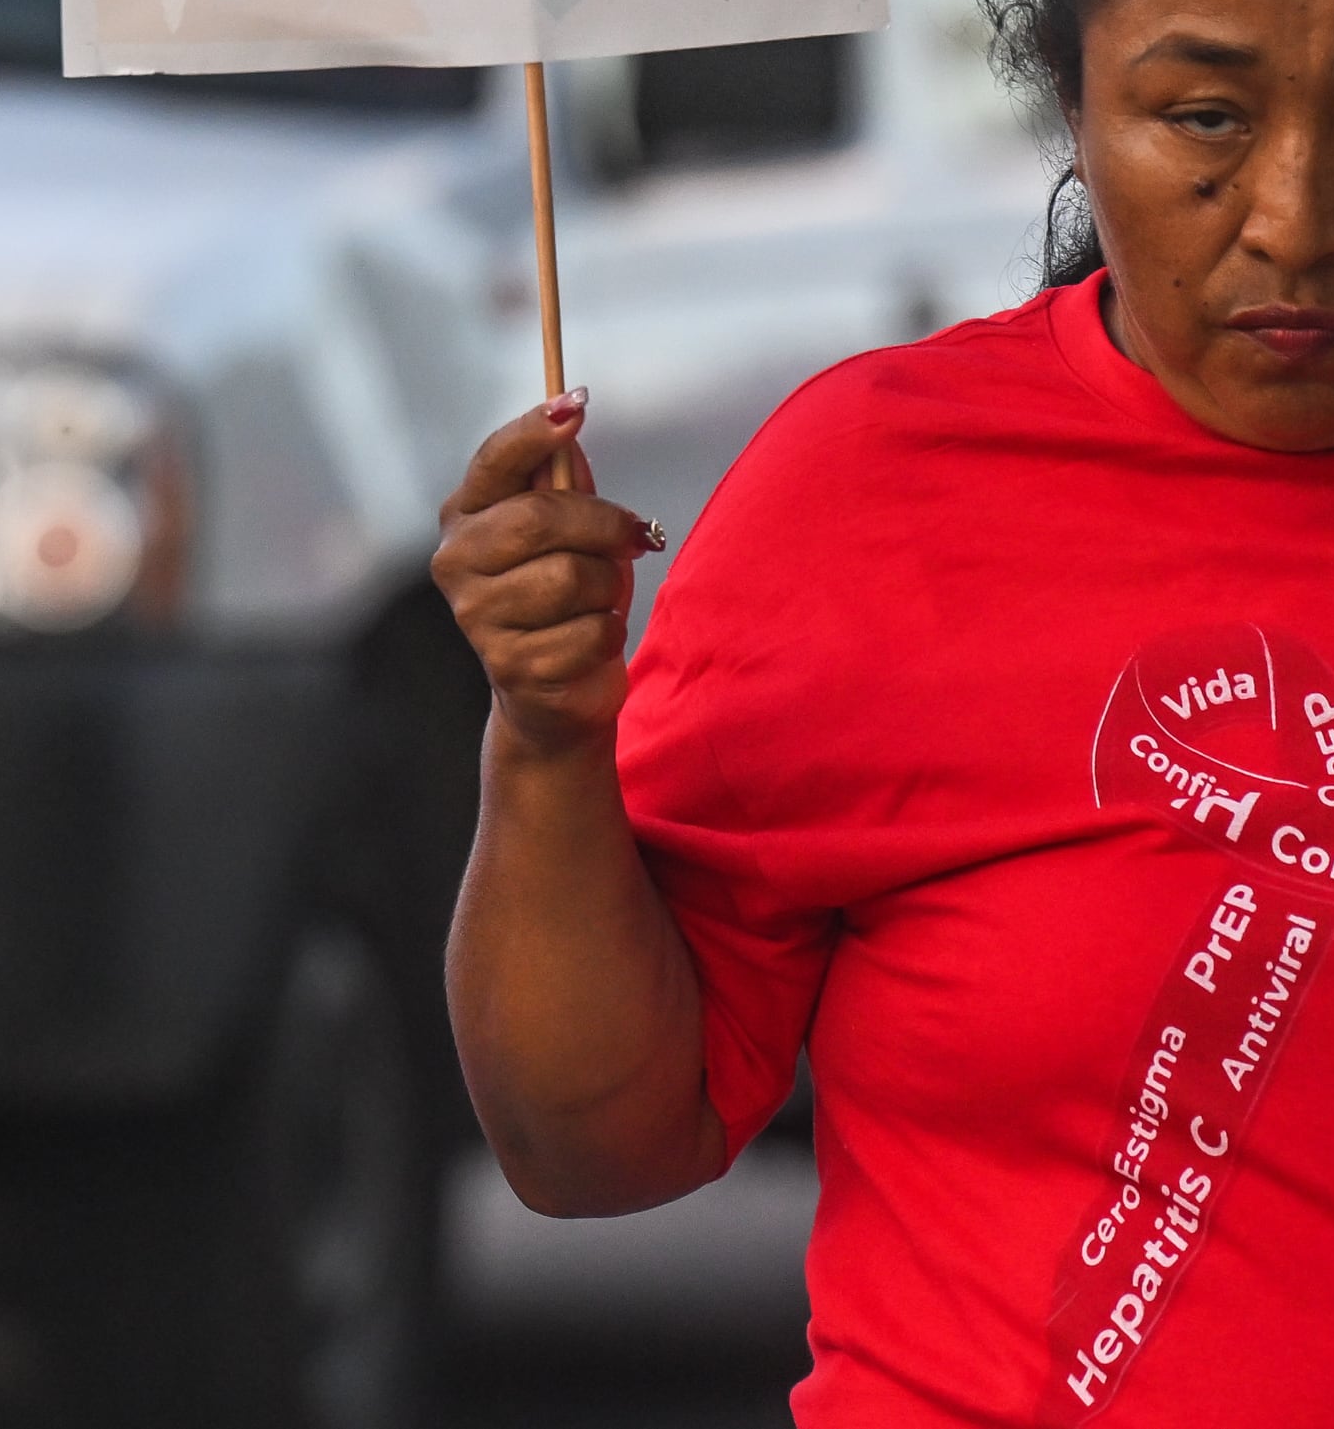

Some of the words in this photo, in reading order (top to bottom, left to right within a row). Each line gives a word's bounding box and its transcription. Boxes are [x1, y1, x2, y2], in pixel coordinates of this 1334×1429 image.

[1161, 668, 1256, 719] Vida
[1131, 735, 1229, 798] Confi
[1185, 885, 1256, 992] PrEP
[1222, 915, 1316, 1091] Antiviral
[1082, 1185, 1140, 1265] Cero
[1115, 1027, 1185, 1181] Estigma
[1067, 1168, 1211, 1406] Hepatitis
[1191, 1116, 1227, 1156] C
